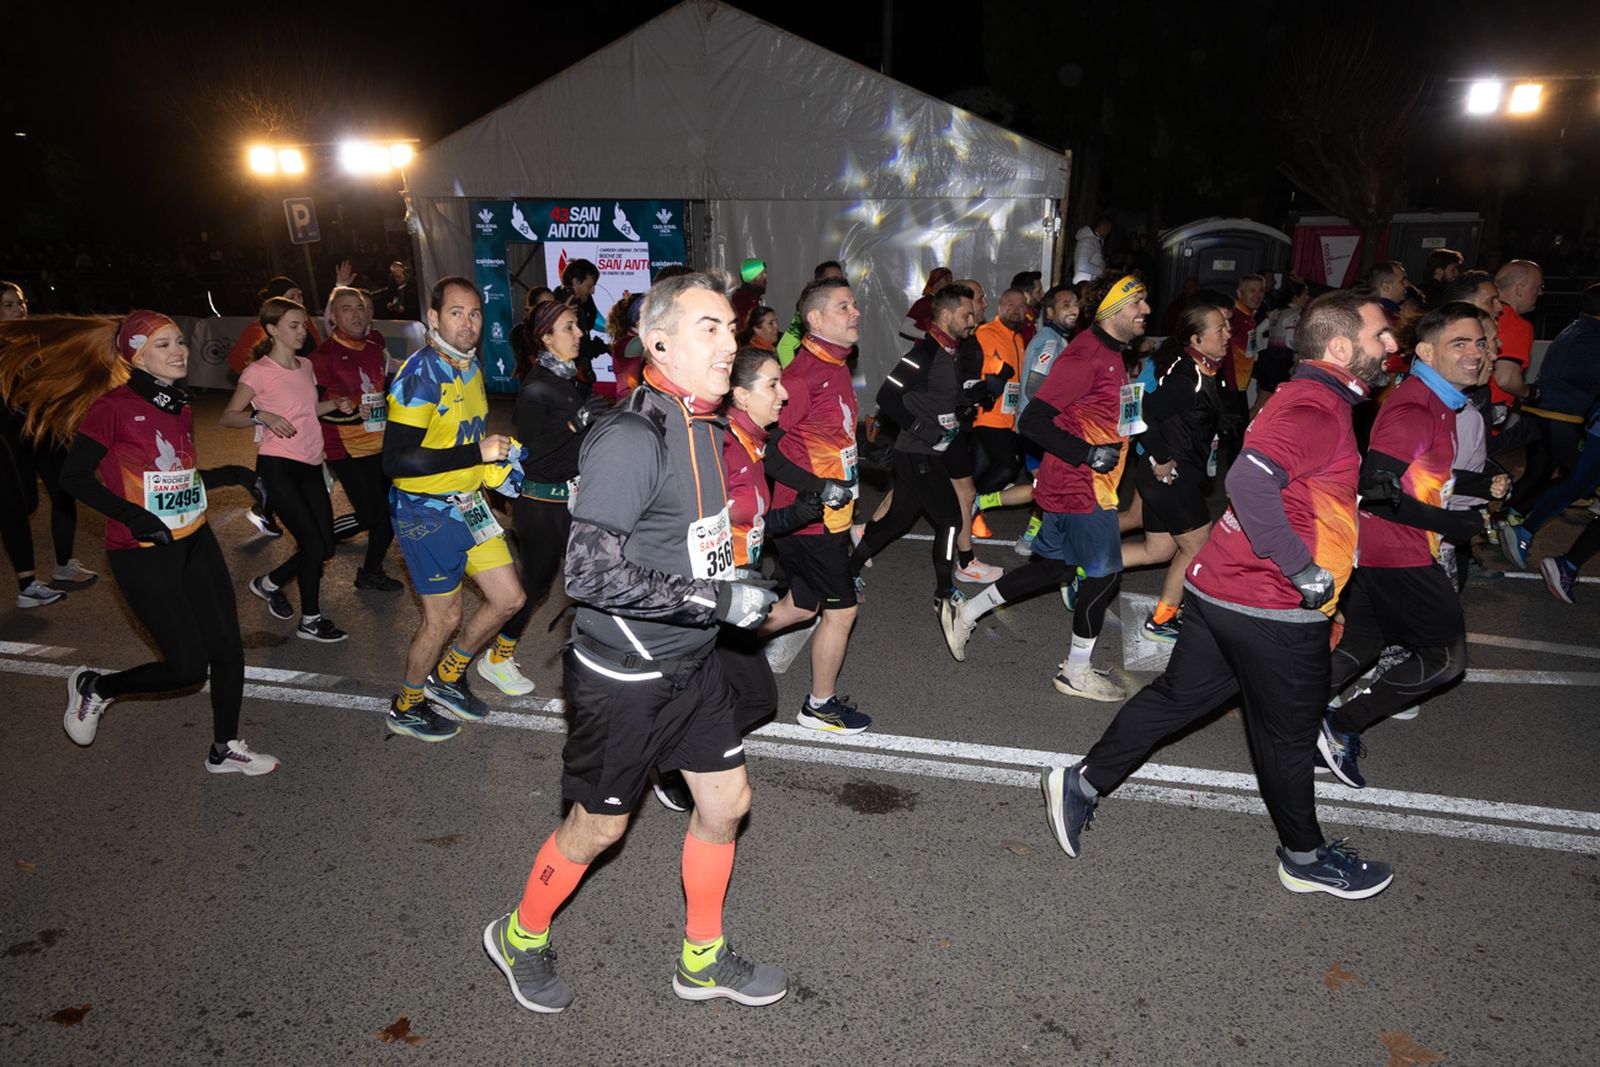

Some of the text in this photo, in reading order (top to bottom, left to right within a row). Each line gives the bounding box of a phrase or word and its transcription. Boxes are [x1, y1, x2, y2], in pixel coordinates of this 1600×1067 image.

[292, 204, 310, 238] P
[550, 206, 601, 222] 43 SAN
[547, 220, 600, 239] ANTÓN
[598, 259, 622, 270] SAN
[153, 484, 169, 492] SAN
[155, 487, 200, 511] 12495
[700, 540, 715, 552] SAN
